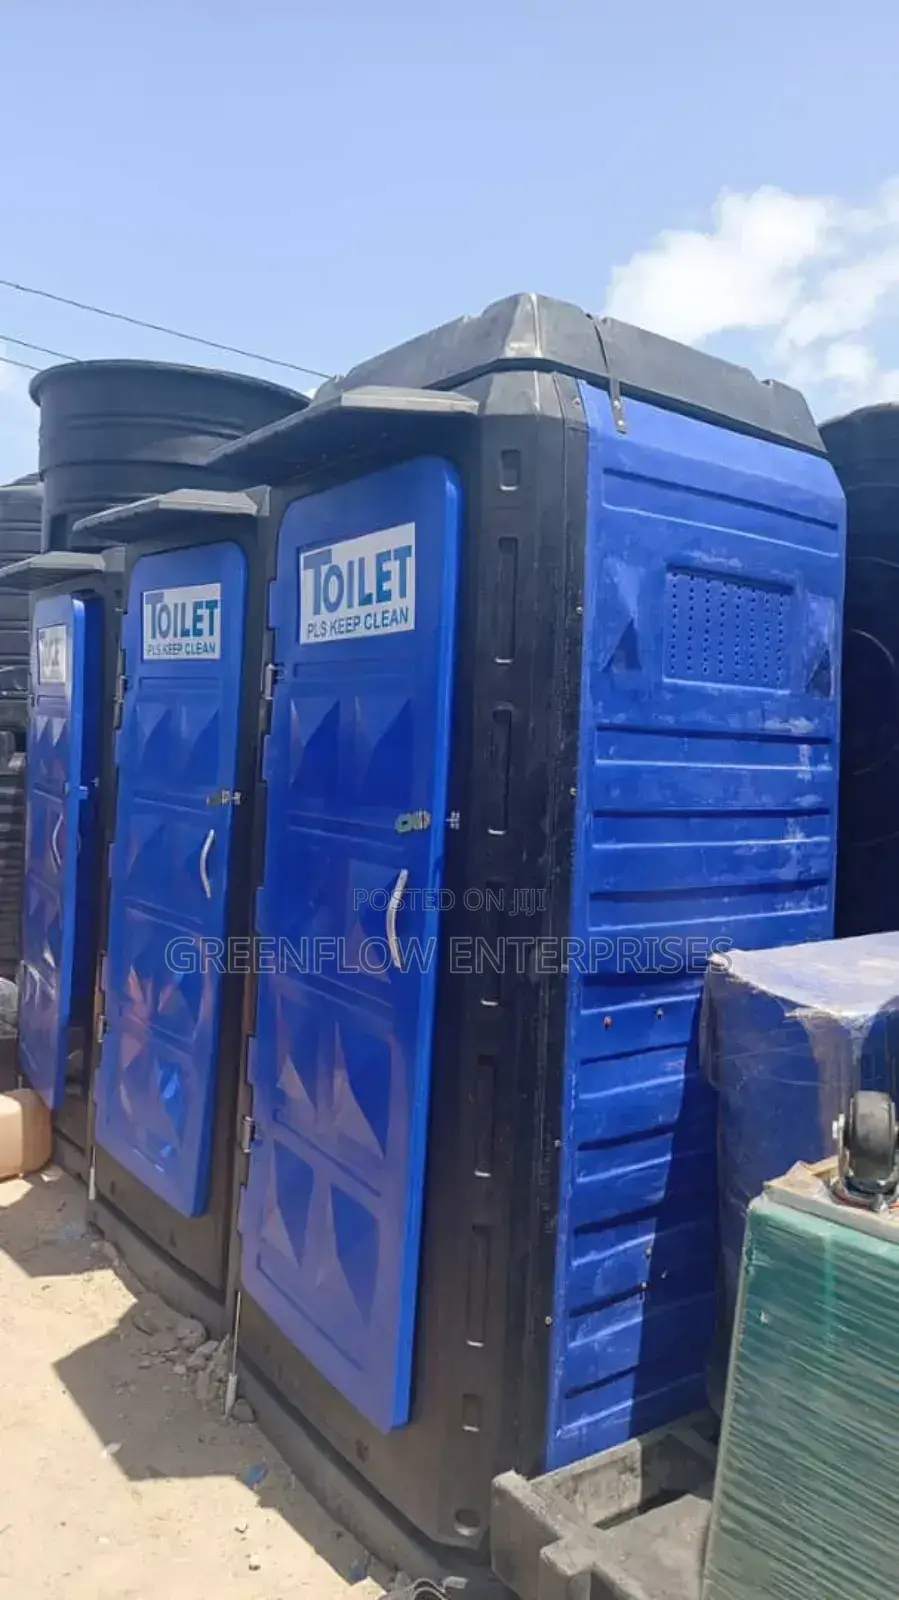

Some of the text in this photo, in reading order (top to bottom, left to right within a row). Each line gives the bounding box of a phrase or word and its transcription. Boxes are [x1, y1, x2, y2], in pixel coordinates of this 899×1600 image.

[303, 545, 412, 616] TOILET
[145, 592, 218, 639] TOILET
[307, 606, 409, 638] PLS KEEP CLEAN
[185, 641, 215, 655] CLEAN
